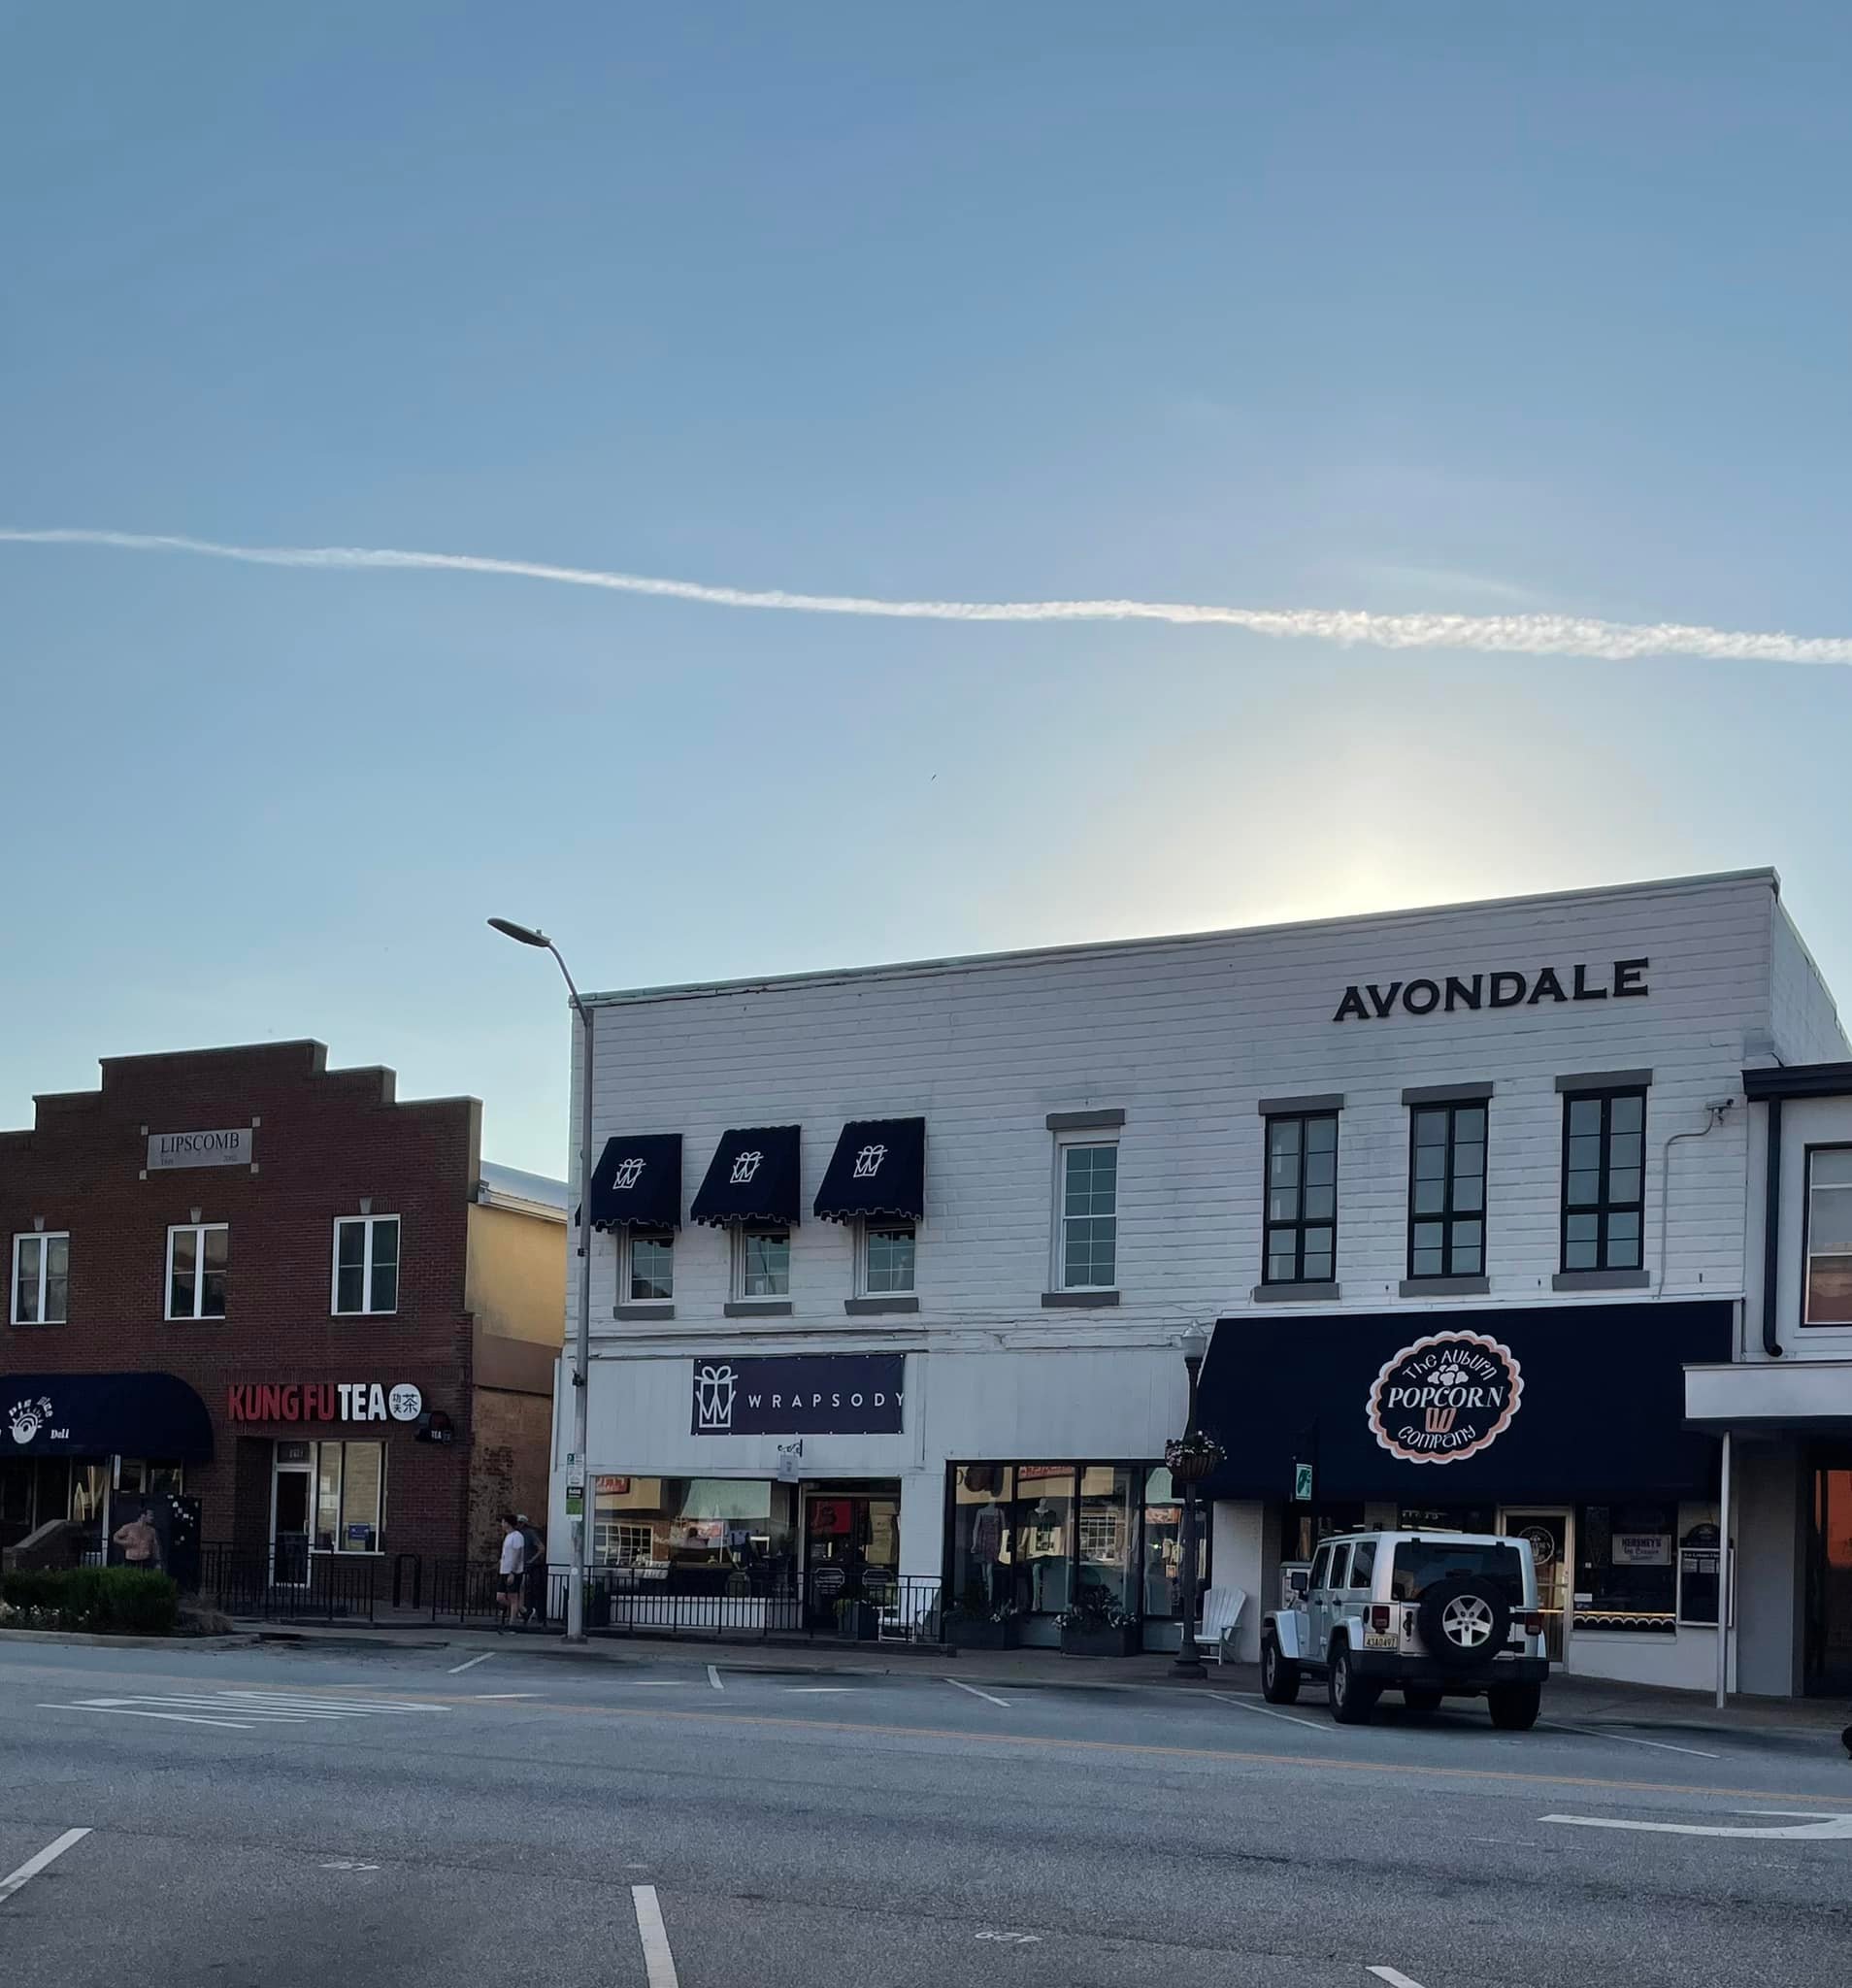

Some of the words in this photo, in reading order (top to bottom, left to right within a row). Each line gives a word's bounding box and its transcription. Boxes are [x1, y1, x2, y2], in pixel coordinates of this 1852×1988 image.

[1333, 957, 1650, 1021] AVONDALE
[161, 1132, 240, 1154] LIPSCOMB
[228, 1383, 299, 1421] KUNG
[303, 1383, 336, 1421] FU
[337, 1382, 387, 1422] TEA
[747, 1392, 905, 1408] WRAPSODY
[1388, 1385, 1505, 1408] POPCORN
[431, 1430, 442, 1440] TEA
